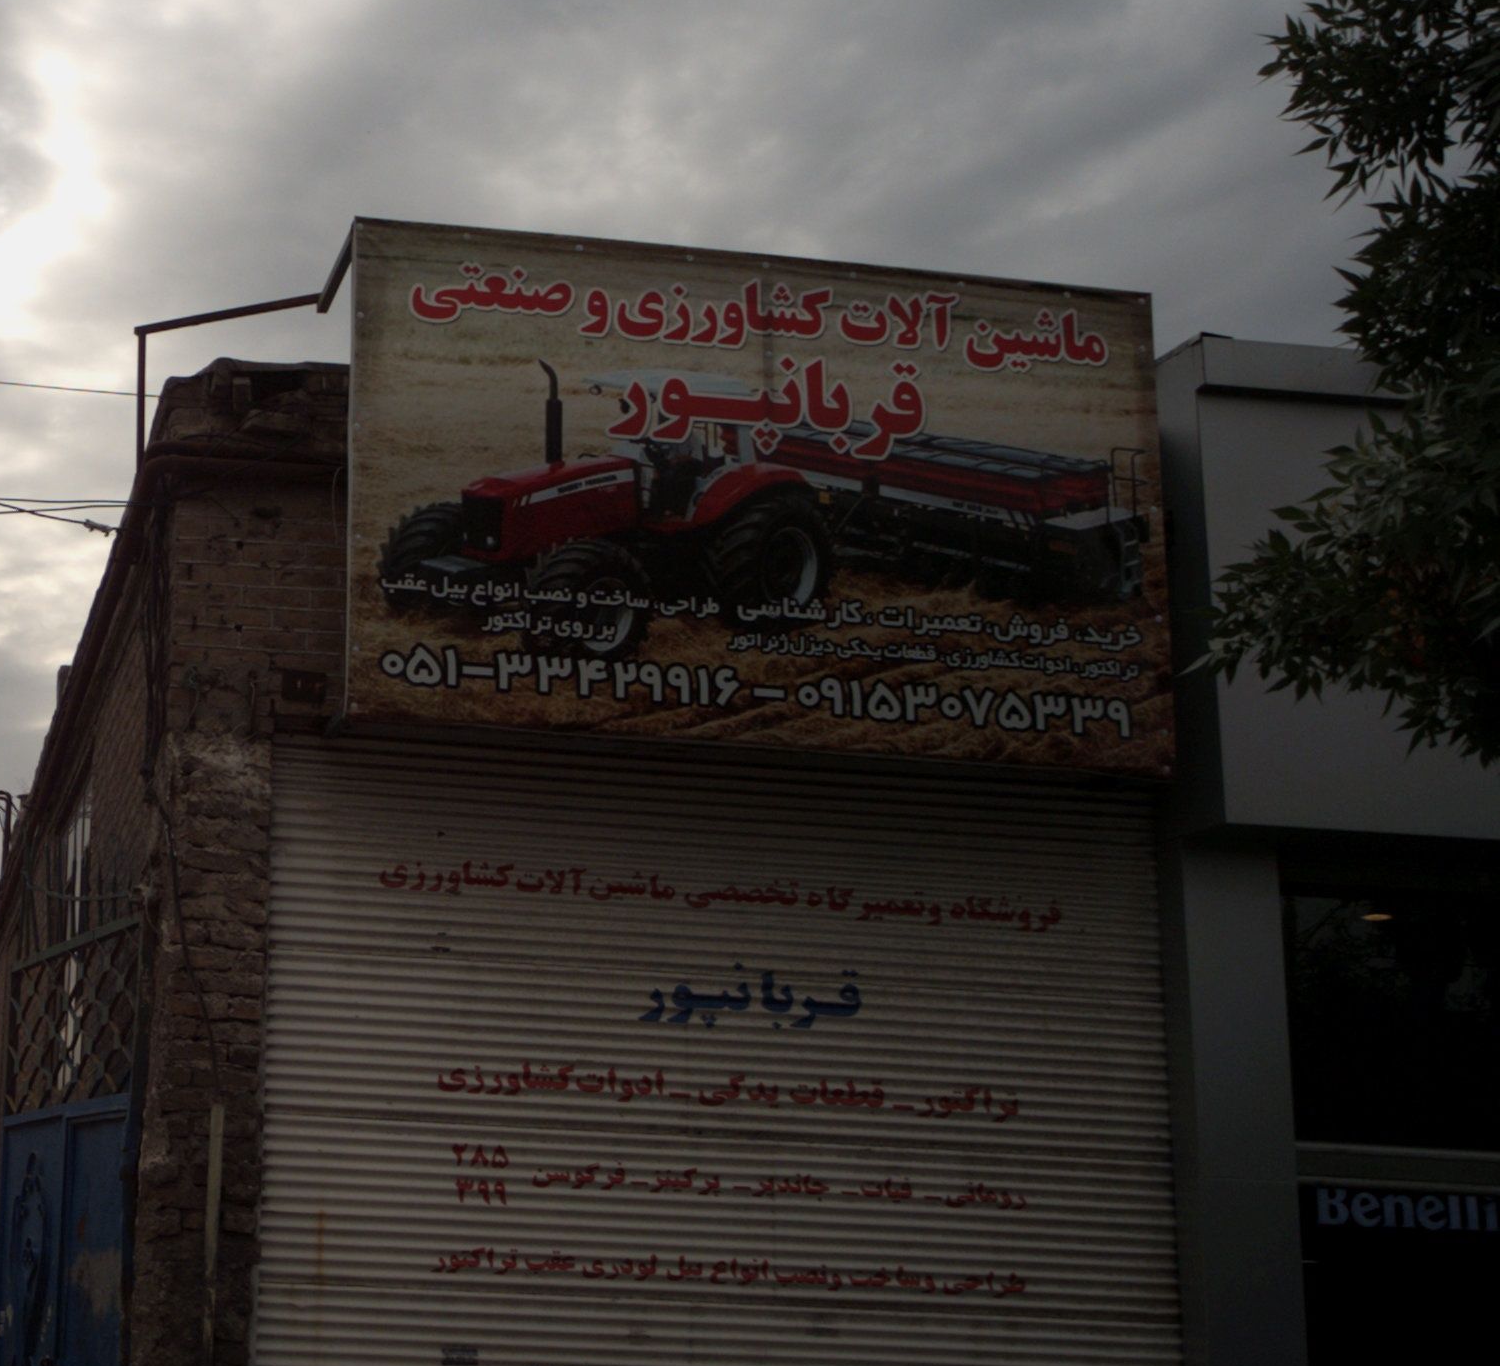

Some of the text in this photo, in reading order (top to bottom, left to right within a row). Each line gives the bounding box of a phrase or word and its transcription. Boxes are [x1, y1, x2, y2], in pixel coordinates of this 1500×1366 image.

[411, 265, 1106, 370] ماشین آلات کشاورزی و صنعتی
[606, 357, 923, 457] قربانپور
[380, 572, 428, 594] عقب
[430, 575, 469, 599] بیل
[470, 579, 520, 606] انواع
[523, 586, 572, 604] نصب
[590, 588, 649, 611] ساخت
[481, 609, 551, 634] تراکتور
[797, 676, 1132, 737] ۰۹۱۵۳۰۷۵۳۳۹
[378, 860, 515, 896] کشاورزی
[515, 867, 588, 895] آلات
[589, 870, 676, 902] ماشین
[684, 880, 800, 909] تخصصی
[950, 895, 1062, 932] فروشگاه
[637, 961, 862, 1028] قربانپور
[438, 1059, 574, 1096] کشاورزی
[575, 1065, 665, 1102] ادوات
[788, 1078, 885, 1109] قطعات
[916, 1086, 1019, 1123] تراکتور
[1315, 1186, 1500, 1232] Benelli
[430, 1246, 519, 1275] تراکتور
[709, 1258, 770, 1286] انواع
[943, 1270, 1026, 1298] طراحی
